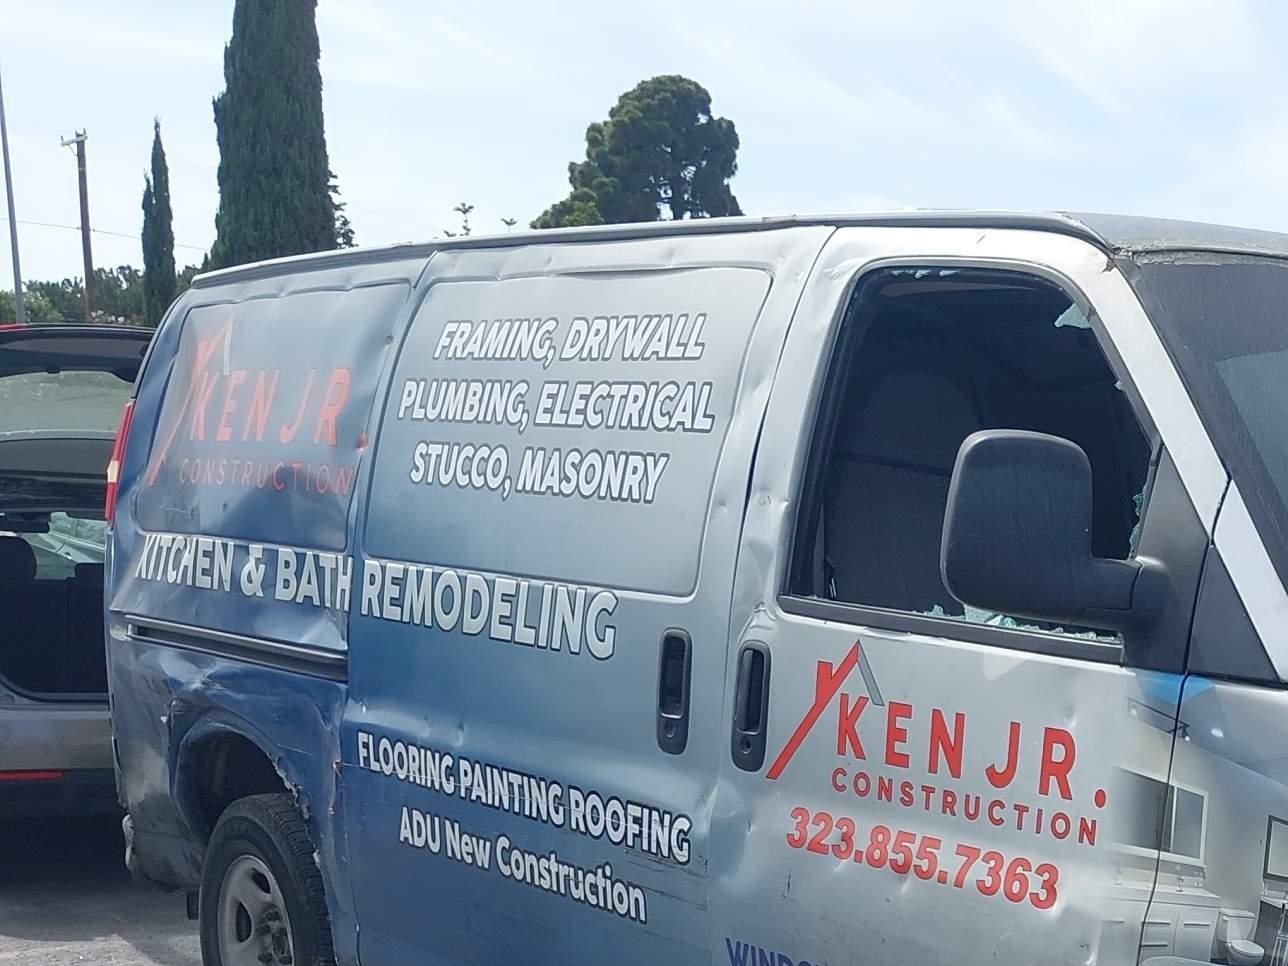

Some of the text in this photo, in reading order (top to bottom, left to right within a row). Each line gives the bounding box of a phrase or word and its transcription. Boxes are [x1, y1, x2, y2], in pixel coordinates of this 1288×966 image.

[433, 313, 707, 370] FRAMING, DRYWALL
[398, 379, 716, 432] PLUMBING, ELECTRICAL
[179, 456, 353, 497] CONSTRUCTION
[410, 442, 669, 504] STUCCO, MASONRY
[135, 534, 619, 660] KITCHEN & BATH REMODELING
[836, 692, 965, 779] KEN
[357, 732, 691, 864] FLOORING PAINTING ROOFING
[831, 766, 1098, 846] CONSTRUCTION
[399, 805, 647, 923] ADU New Construction
[786, 806, 1060, 910] 323.855.7363
